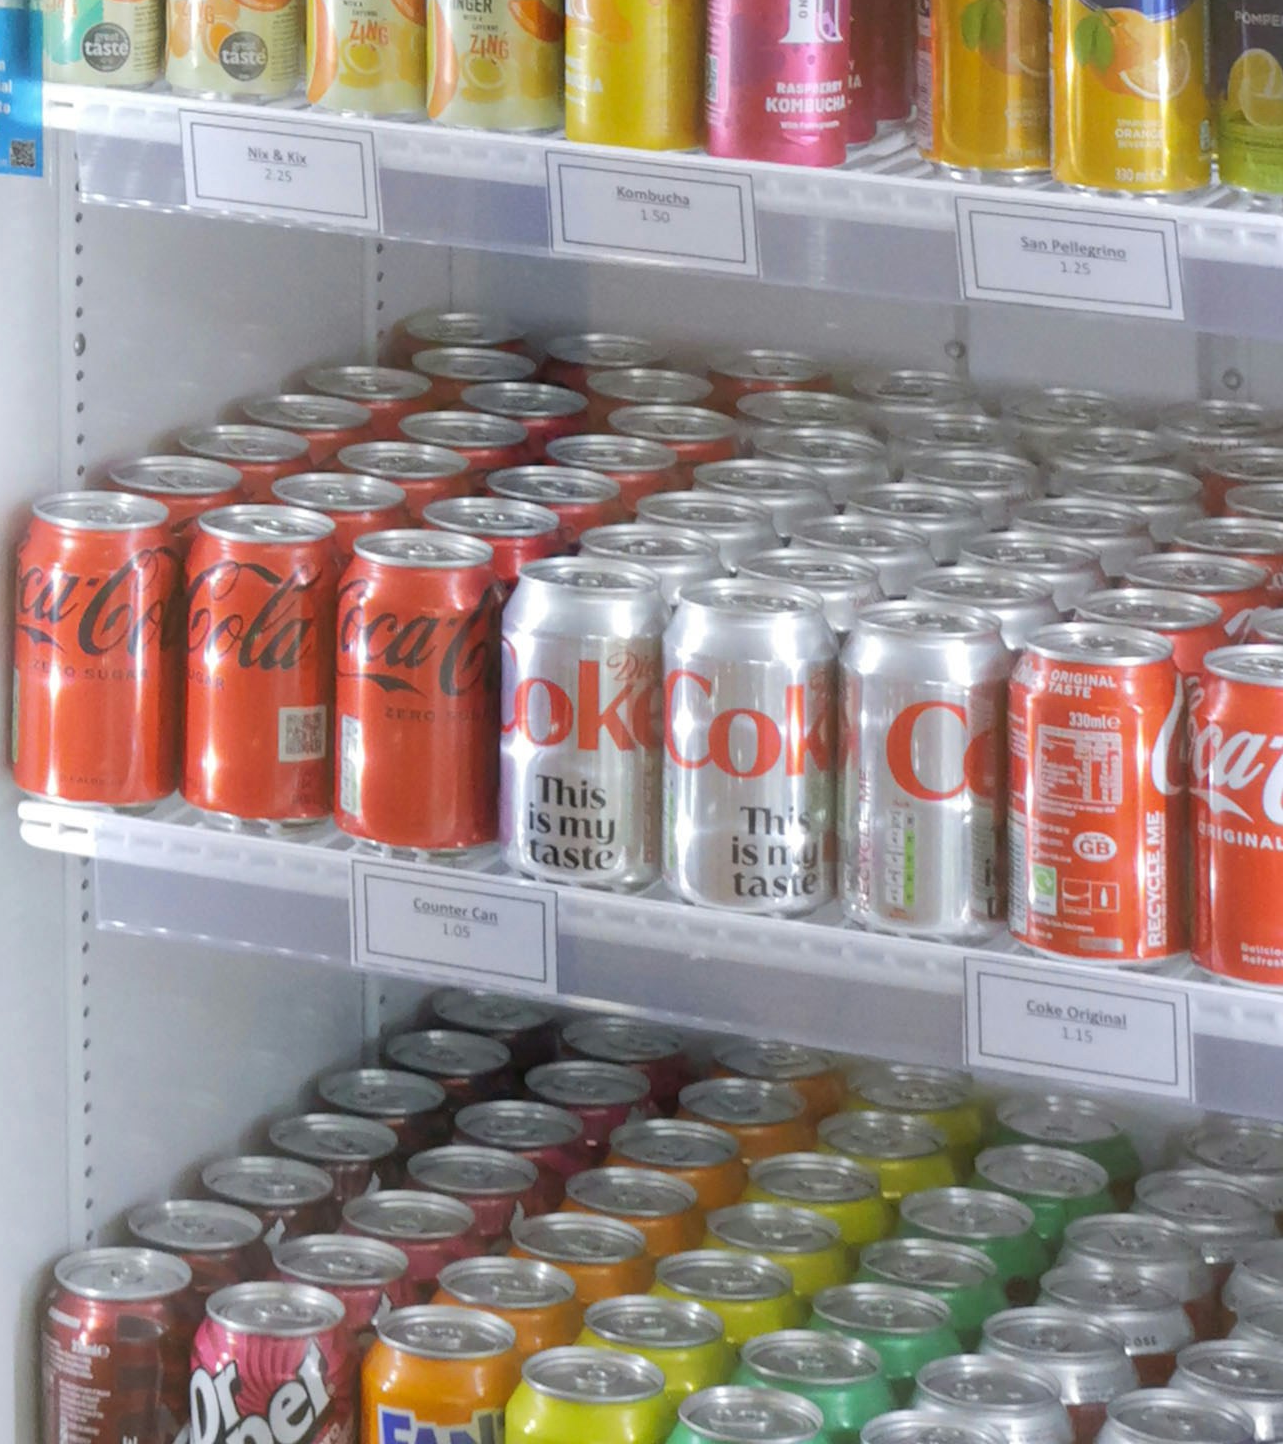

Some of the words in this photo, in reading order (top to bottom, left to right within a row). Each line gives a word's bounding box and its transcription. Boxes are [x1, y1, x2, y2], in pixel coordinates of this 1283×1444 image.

[766, 95, 846, 114] KOMBUCHA
[247, 145, 269, 161] Nix
[273, 149, 284, 161] &
[287, 151, 307, 165] Kix
[265, 168, 292, 183] 2.25
[616, 186, 690, 207] Kombucha
[640, 209, 671, 224] 1.50
[1020, 235, 1048, 252] San
[1051, 238, 1127, 260] Pellegrino
[1060, 261, 1091, 275] 1.25
[1050, 669, 1116, 689] ORIGINAL
[1047, 681, 1092, 700] TASTE
[536, 774, 606, 810] This
[528, 801, 552, 834] is
[559, 818, 616, 846] my
[1147, 811, 1161, 845] ME
[529, 841, 615, 870] taste
[1080, 841, 1112, 858] GB
[1147, 849, 1163, 949] RECYCLE
[413, 897, 468, 917] Counter
[471, 906, 499, 923] Can
[442, 923, 471, 939] 1.05
[1027, 999, 1063, 1017] Coke
[1066, 1006, 1128, 1027] Original
[1061, 1026, 1094, 1044] 1.15
